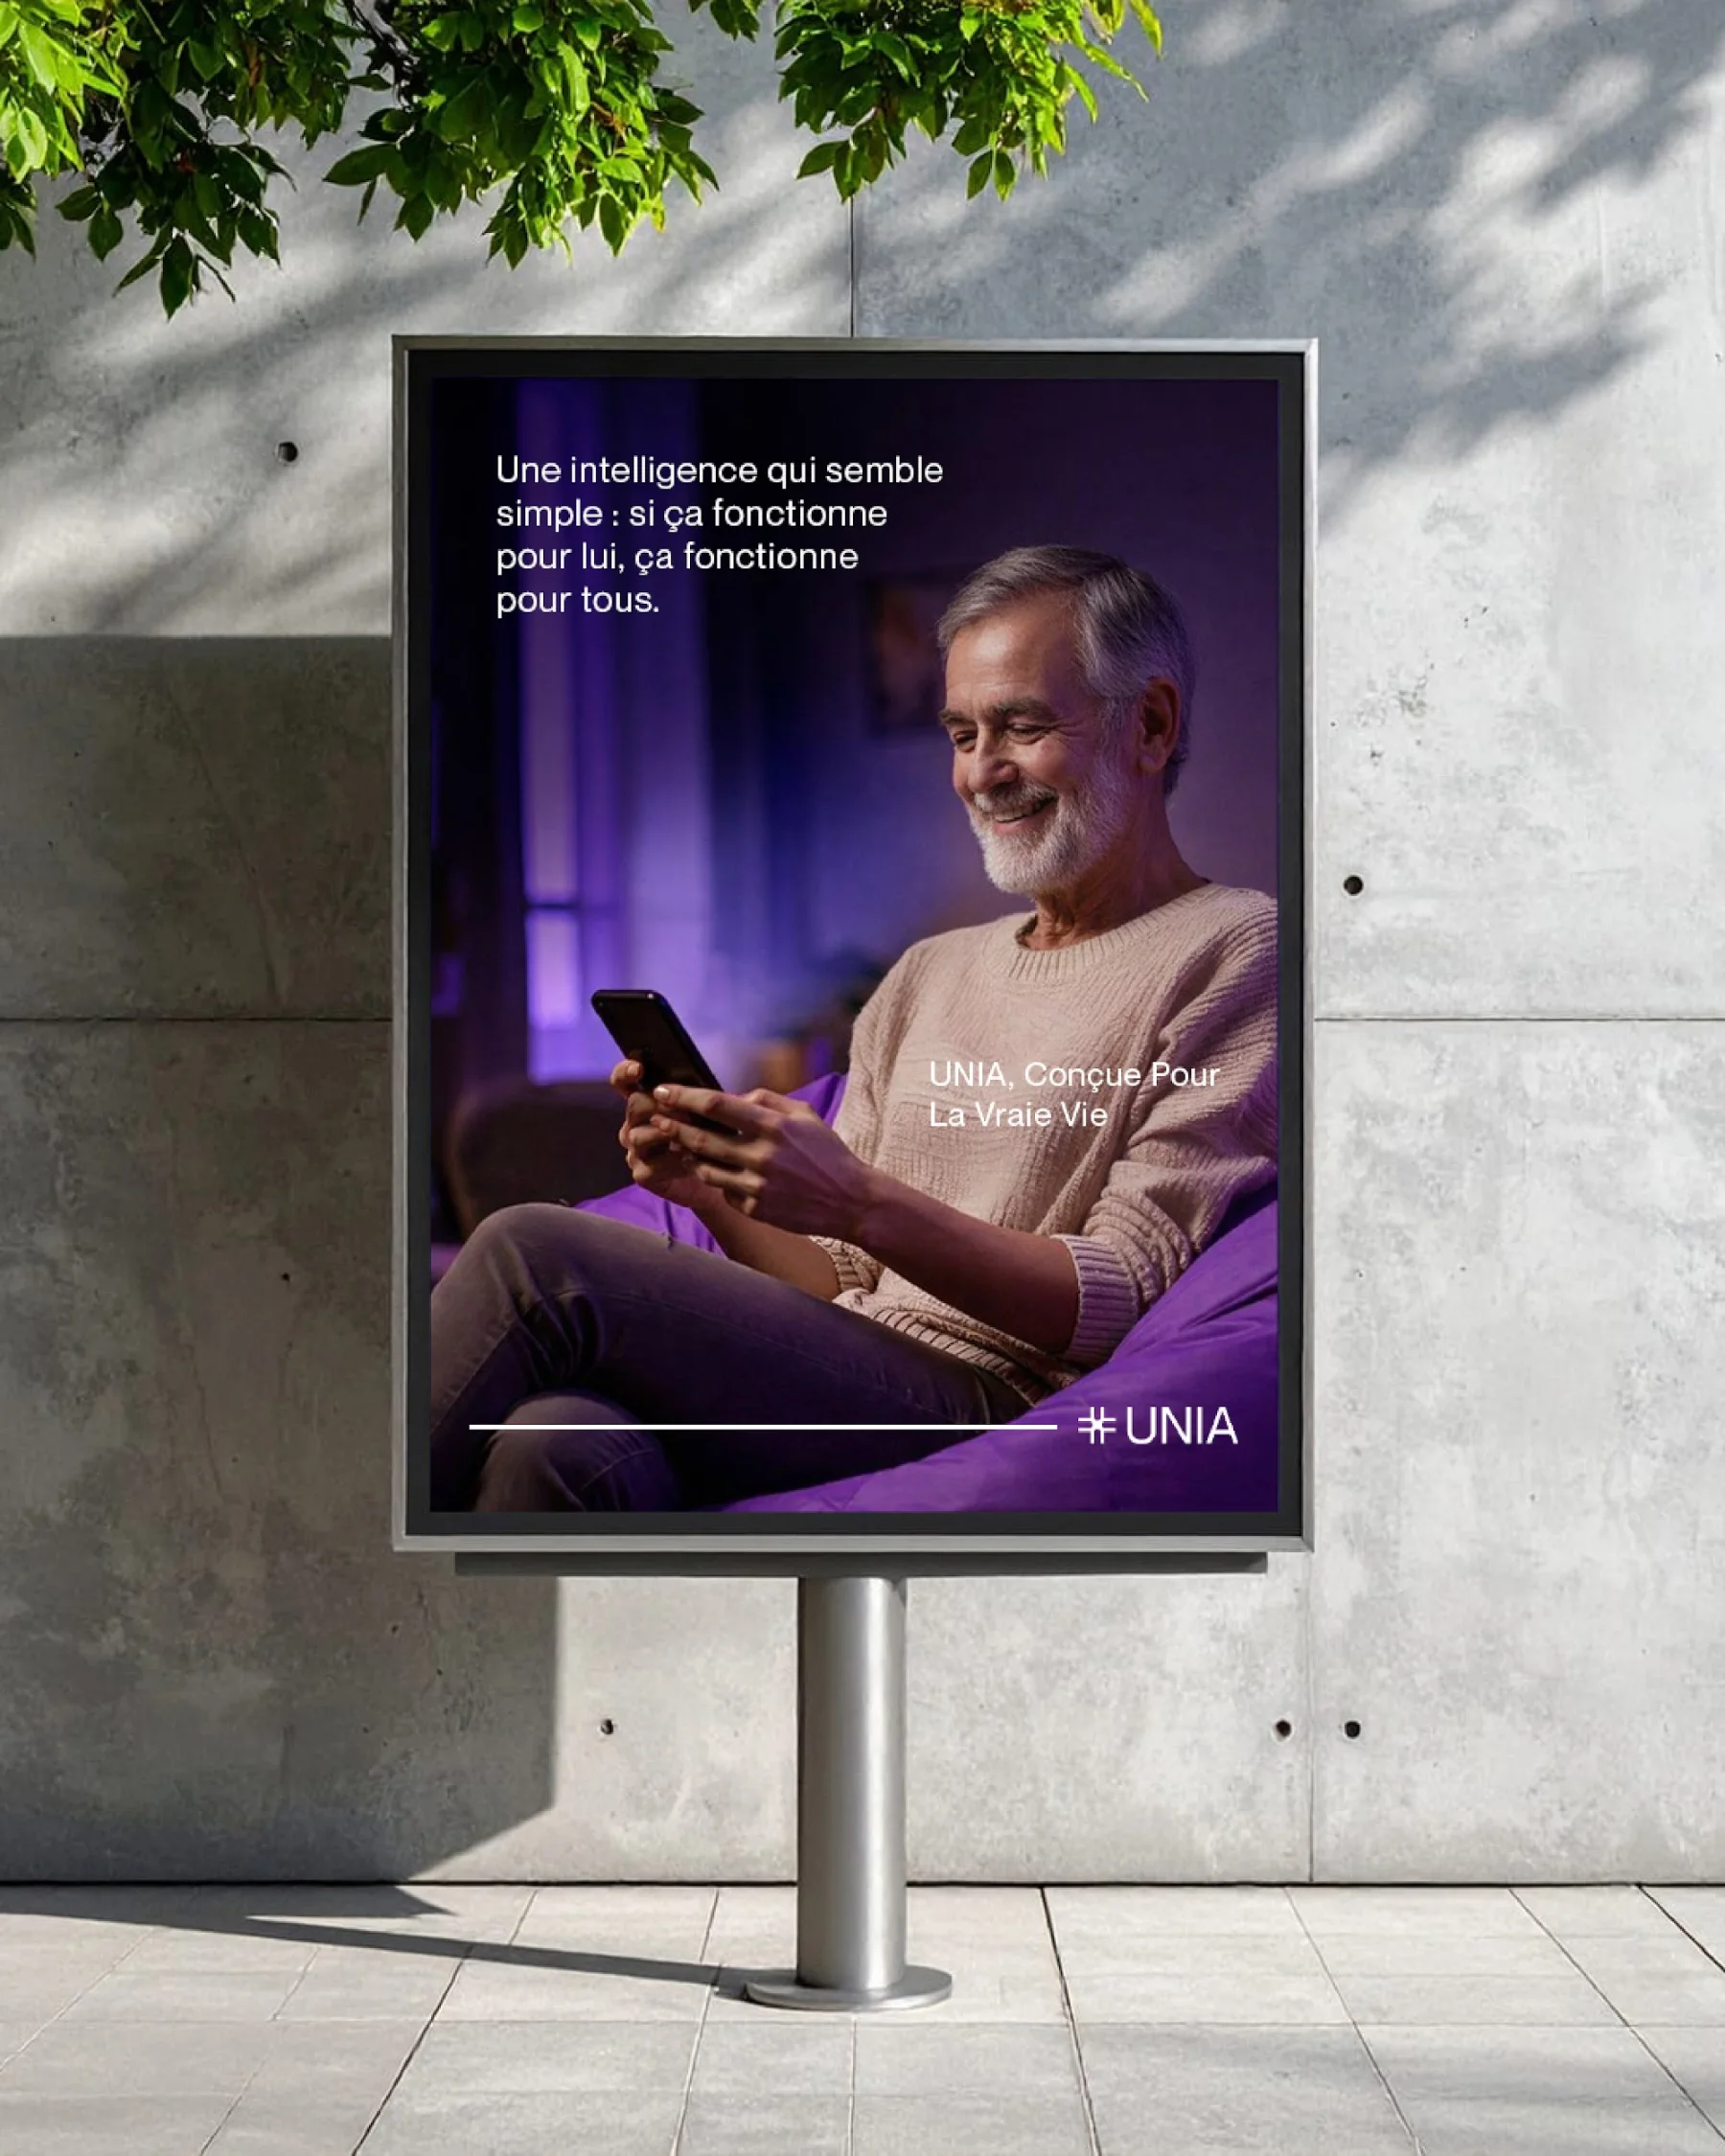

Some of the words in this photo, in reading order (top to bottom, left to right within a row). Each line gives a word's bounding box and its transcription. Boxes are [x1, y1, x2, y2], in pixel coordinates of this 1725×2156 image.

[497, 454, 562, 483] Une
[571, 455, 758, 490] intelligence
[767, 456, 816, 490] qui
[825, 455, 943, 483] semble
[496, 498, 603, 533] simple
[629, 498, 655, 527] si
[663, 505, 703, 533] ça
[713, 497, 887, 527] fonctionne
[497, 548, 572, 576] pour
[582, 541, 625, 574] lui,
[634, 548, 674, 576] ça
[683, 540, 859, 569] fonctionne
[497, 591, 572, 619] pour
[581, 586, 659, 613] tous.
[930, 1061, 1014, 1090] UNIA,
[1024, 1061, 1141, 1093] Conçue
[1152, 1061, 1221, 1088] Pour
[930, 1101, 966, 1127] La
[975, 1101, 1052, 1127] Vraie
[1060, 1101, 1108, 1127] Vie
[1127, 1406, 1239, 1445] UNIA
